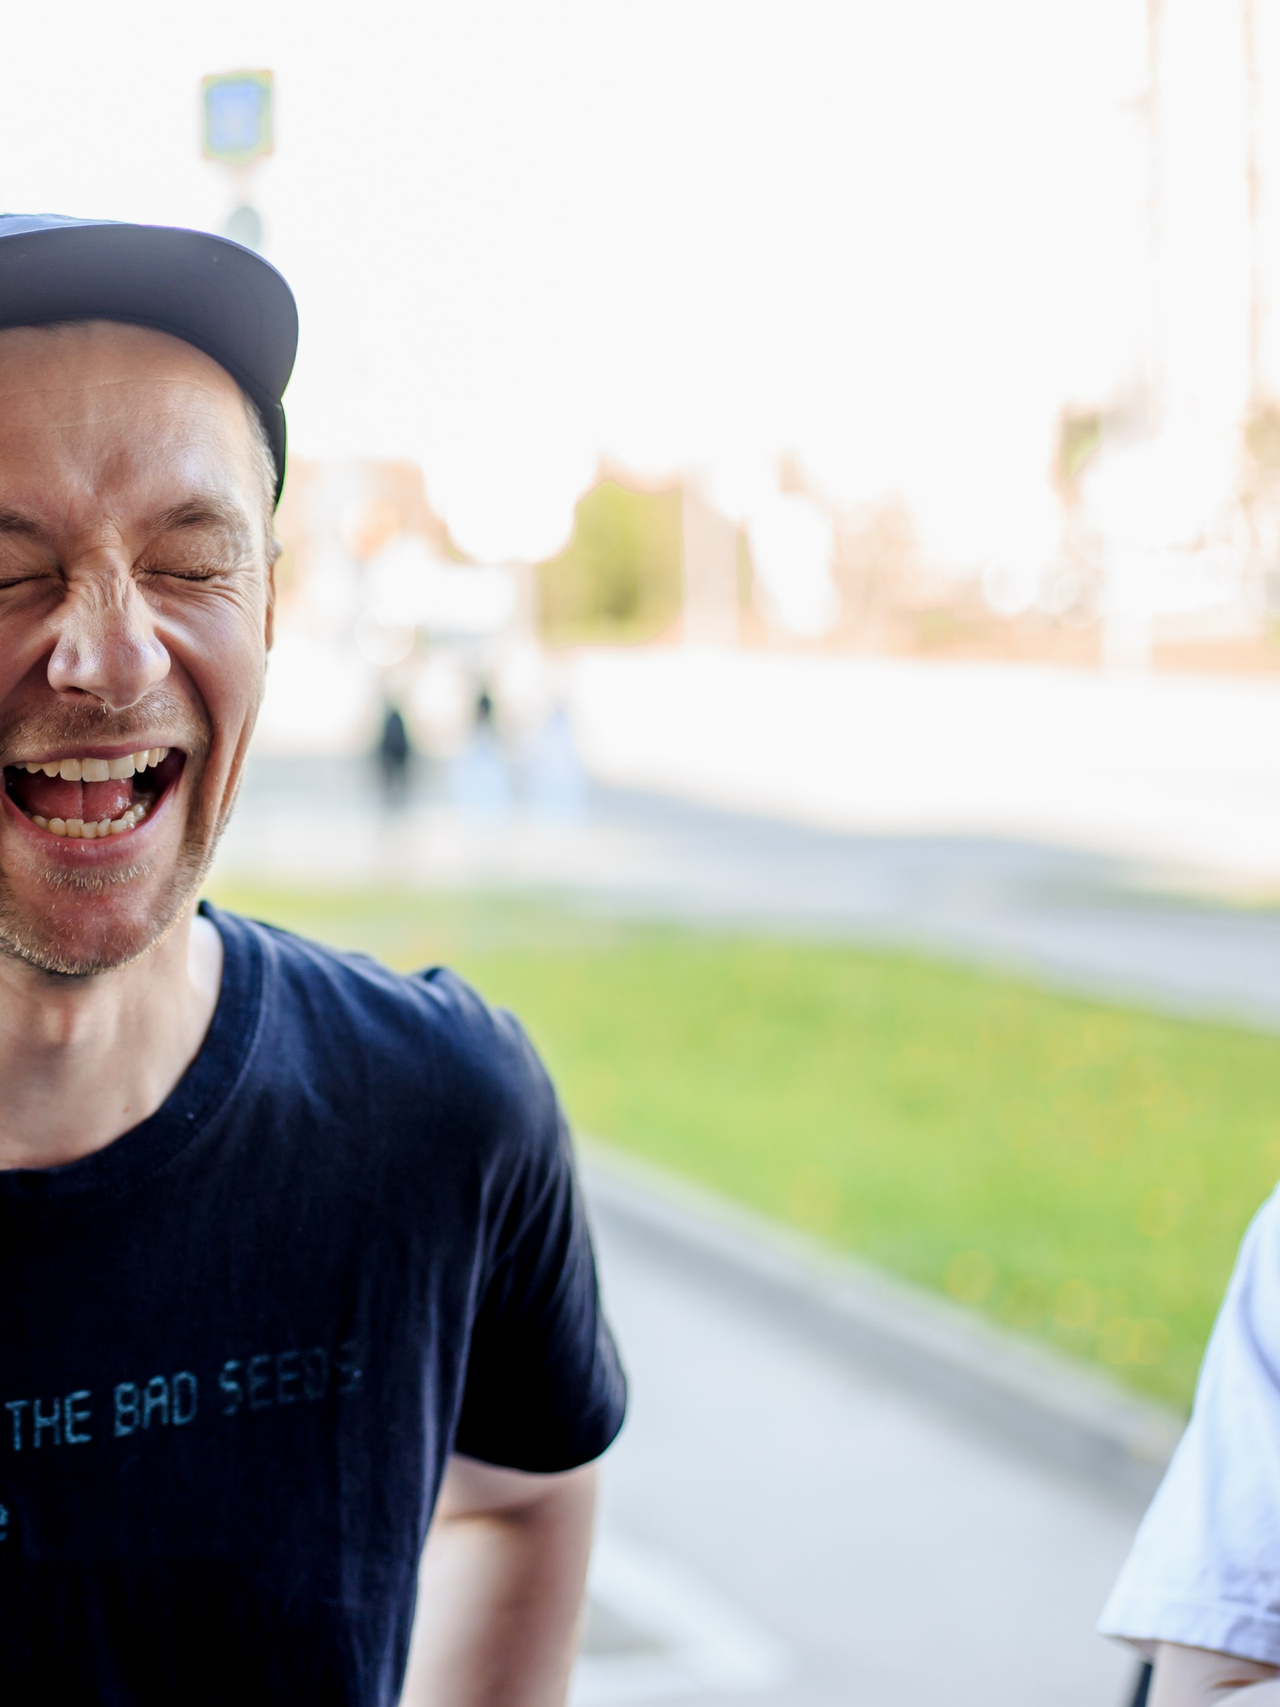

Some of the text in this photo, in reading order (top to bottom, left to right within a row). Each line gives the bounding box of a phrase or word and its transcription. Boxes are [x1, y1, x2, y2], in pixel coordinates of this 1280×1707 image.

[4, 1388, 93, 1452] THE
[112, 1369, 199, 1438] BAD
[218, 1338, 362, 1417] SEEDS
